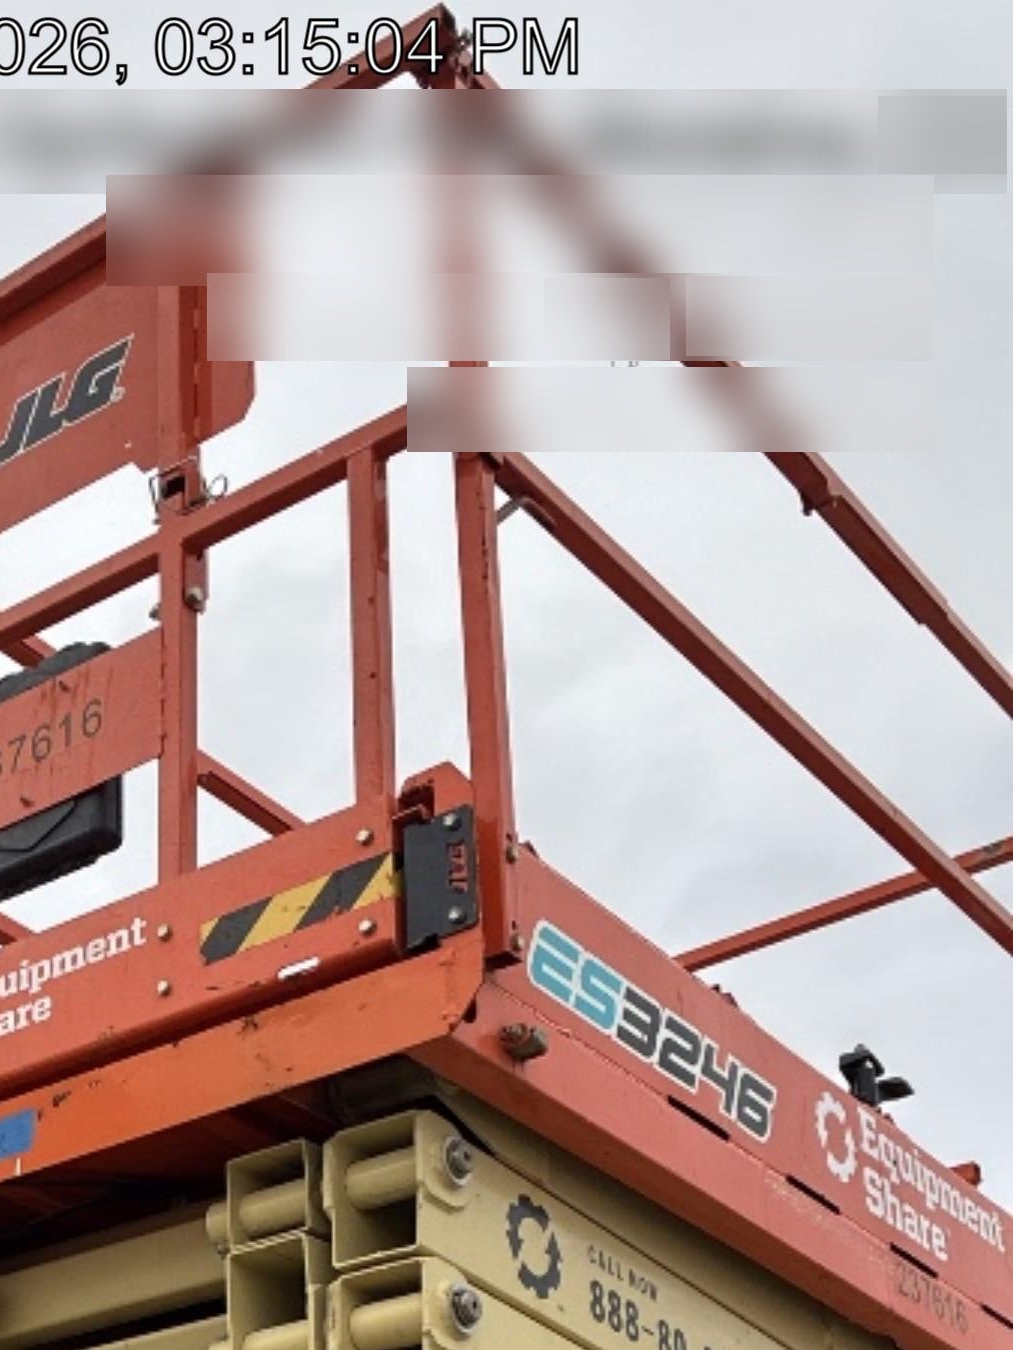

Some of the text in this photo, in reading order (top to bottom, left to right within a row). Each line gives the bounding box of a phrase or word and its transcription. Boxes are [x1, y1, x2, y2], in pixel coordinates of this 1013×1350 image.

[527, 918, 777, 1143] ES3246
[857, 1105, 1006, 1254] Equipment
[863, 1166, 949, 1262] Share
[587, 1245, 625, 1281] CALL
